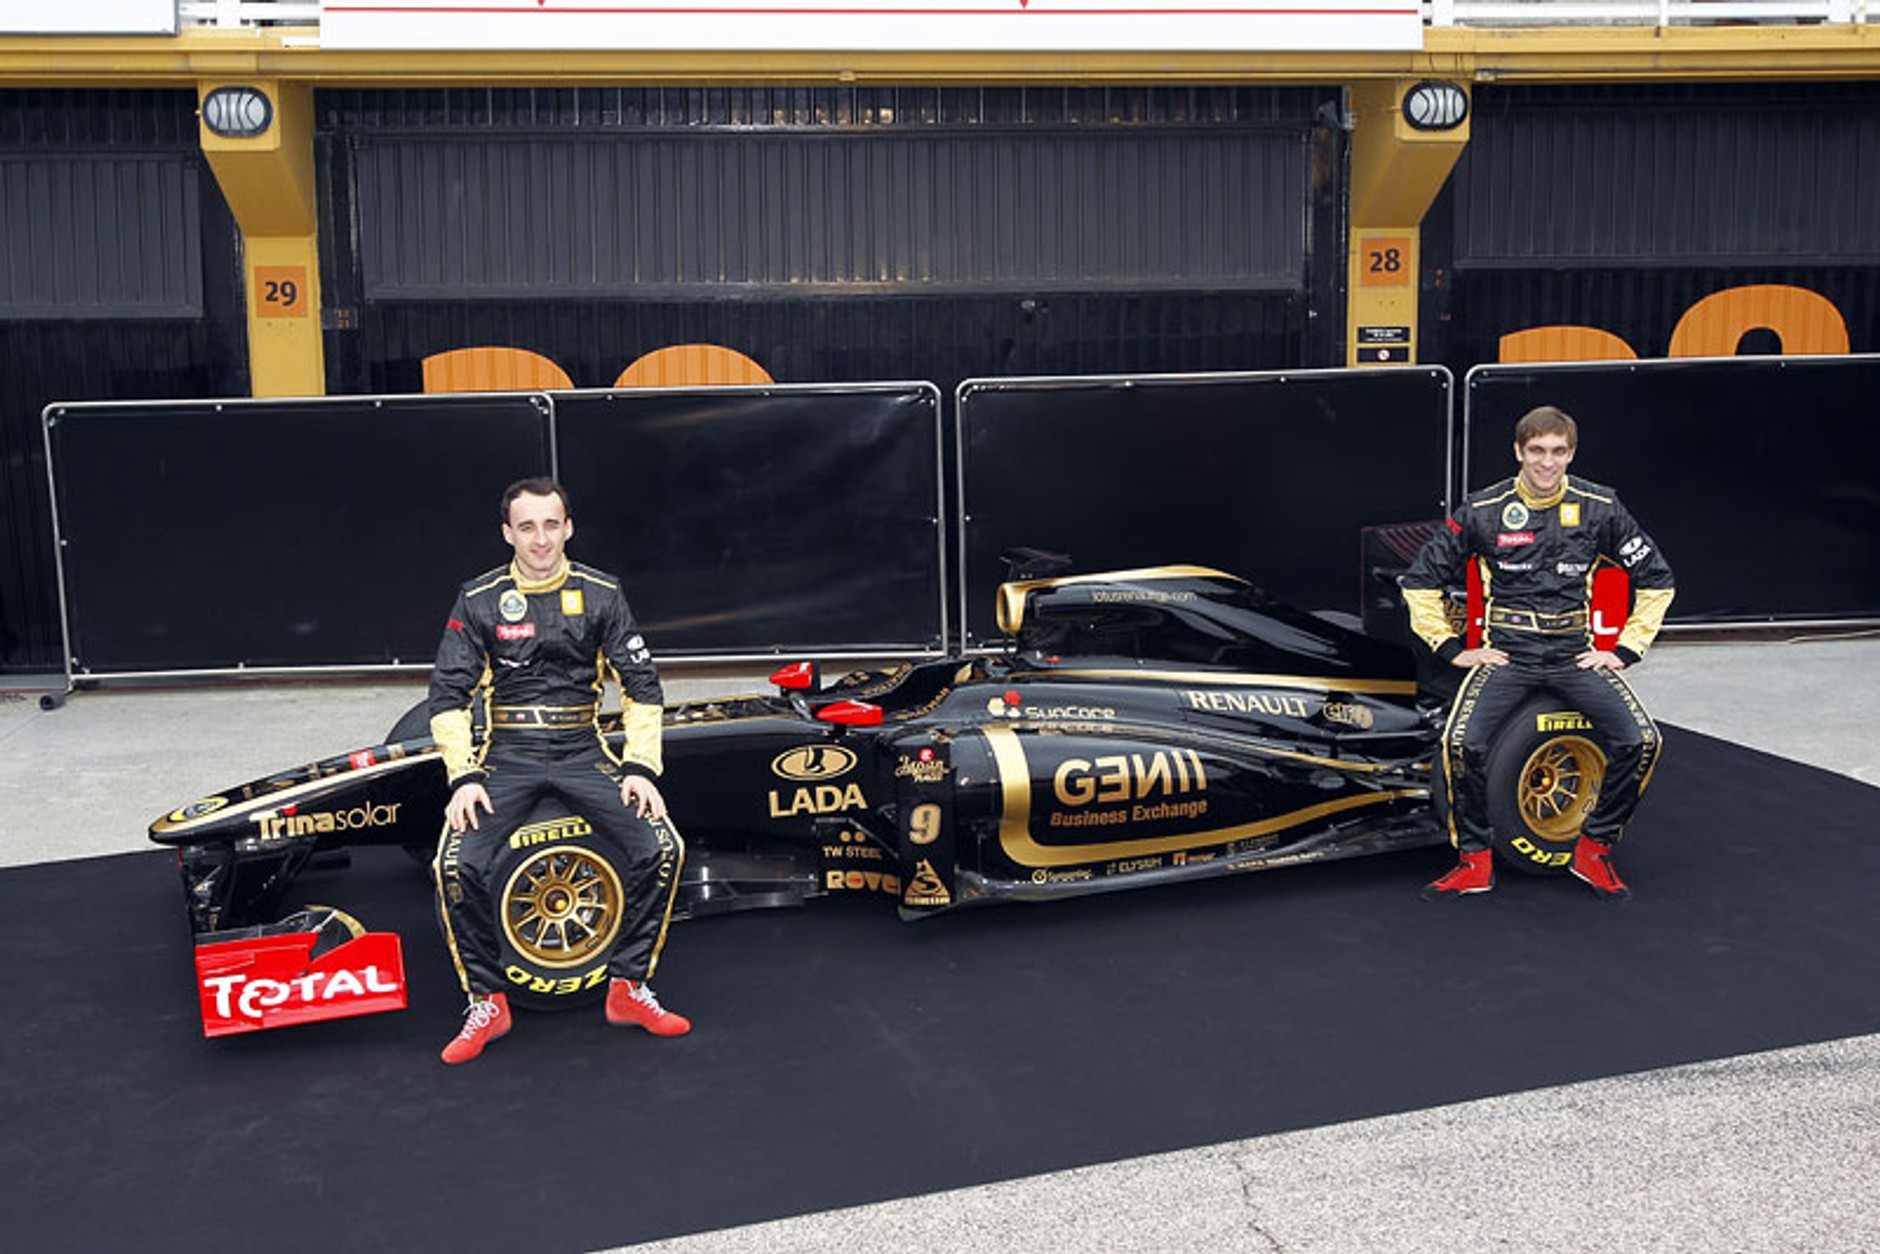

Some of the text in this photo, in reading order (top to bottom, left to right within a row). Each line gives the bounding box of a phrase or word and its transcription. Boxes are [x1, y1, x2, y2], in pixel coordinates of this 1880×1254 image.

[1370, 248, 1400, 272] 28
[264, 280, 297, 306] 29
[1187, 689, 1309, 718] RENAULT
[1536, 711, 1594, 733] PIRELL
[769, 784, 868, 818] LADA
[1050, 799, 1209, 829] Business Exchange
[510, 815, 593, 849] PIRELLI
[909, 803, 942, 845] 9
[822, 846, 844, 858] TW
[1510, 836, 1573, 866] ERO
[204, 964, 398, 1018] TOTAL
[504, 963, 613, 995] ZERO
